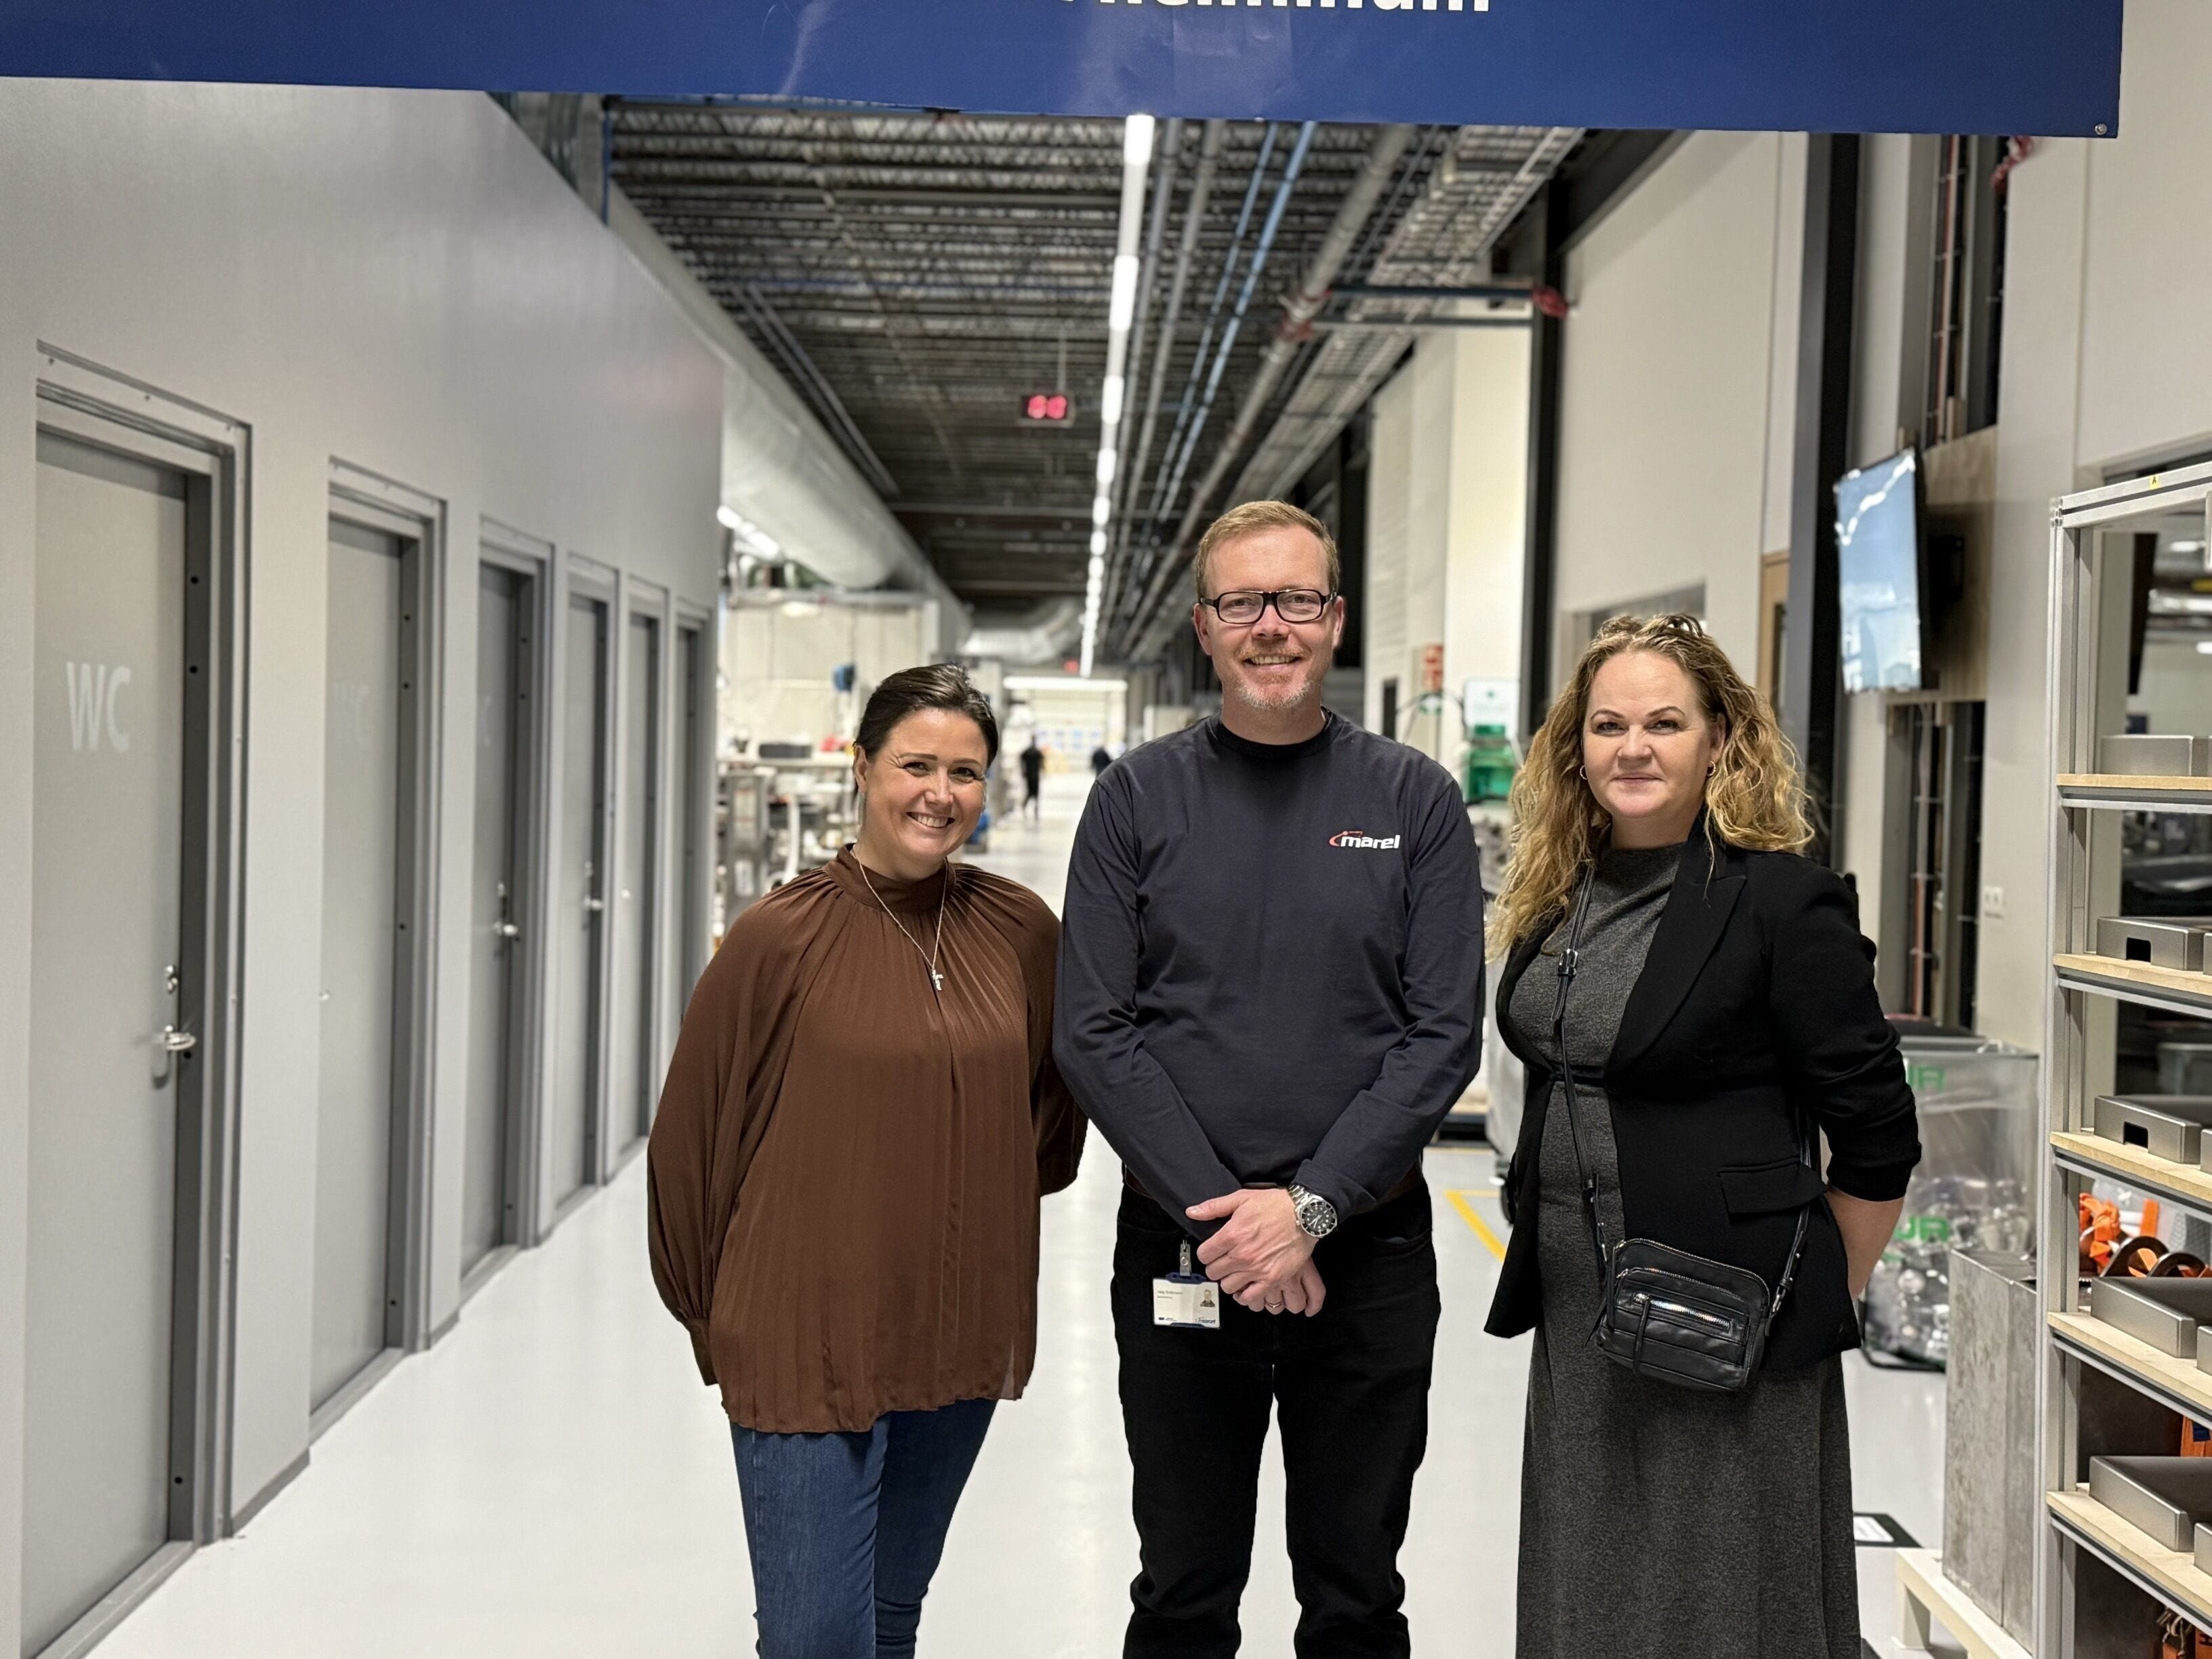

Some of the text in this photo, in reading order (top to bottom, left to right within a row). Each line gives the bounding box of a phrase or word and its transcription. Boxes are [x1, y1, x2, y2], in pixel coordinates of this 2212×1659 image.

[2152, 476, 2157, 485] A
[66, 661, 131, 752] WC
[1340, 834, 1401, 849] marel
